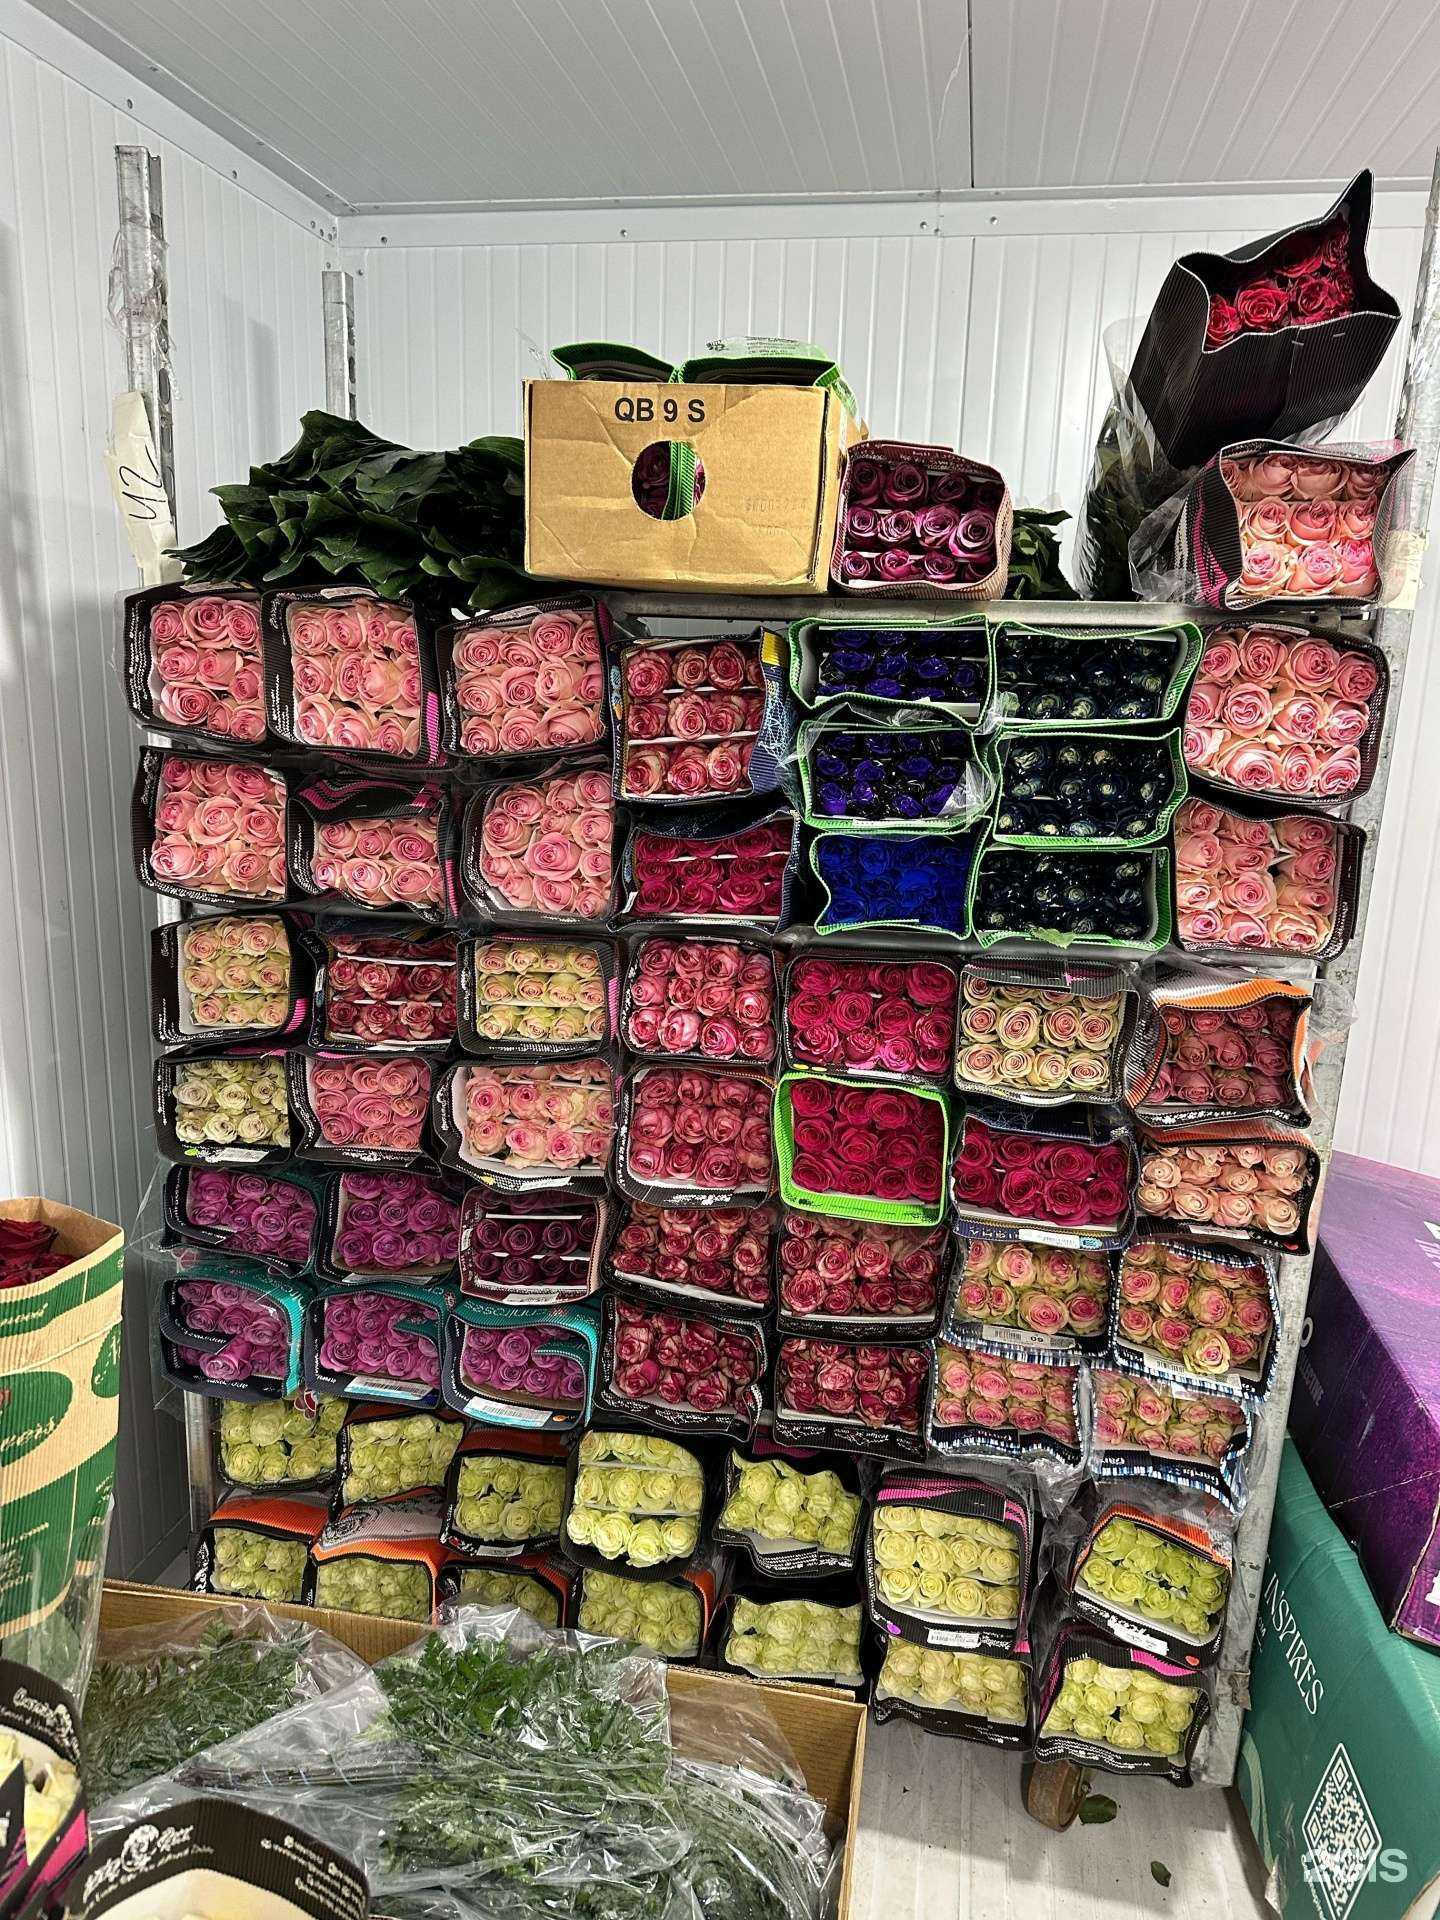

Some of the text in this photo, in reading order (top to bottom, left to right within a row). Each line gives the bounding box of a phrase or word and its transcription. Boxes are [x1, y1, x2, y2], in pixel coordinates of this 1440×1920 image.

[615, 397, 706, 423] QB 9 S
[1263, 1571, 1324, 1715] INSPIRES
